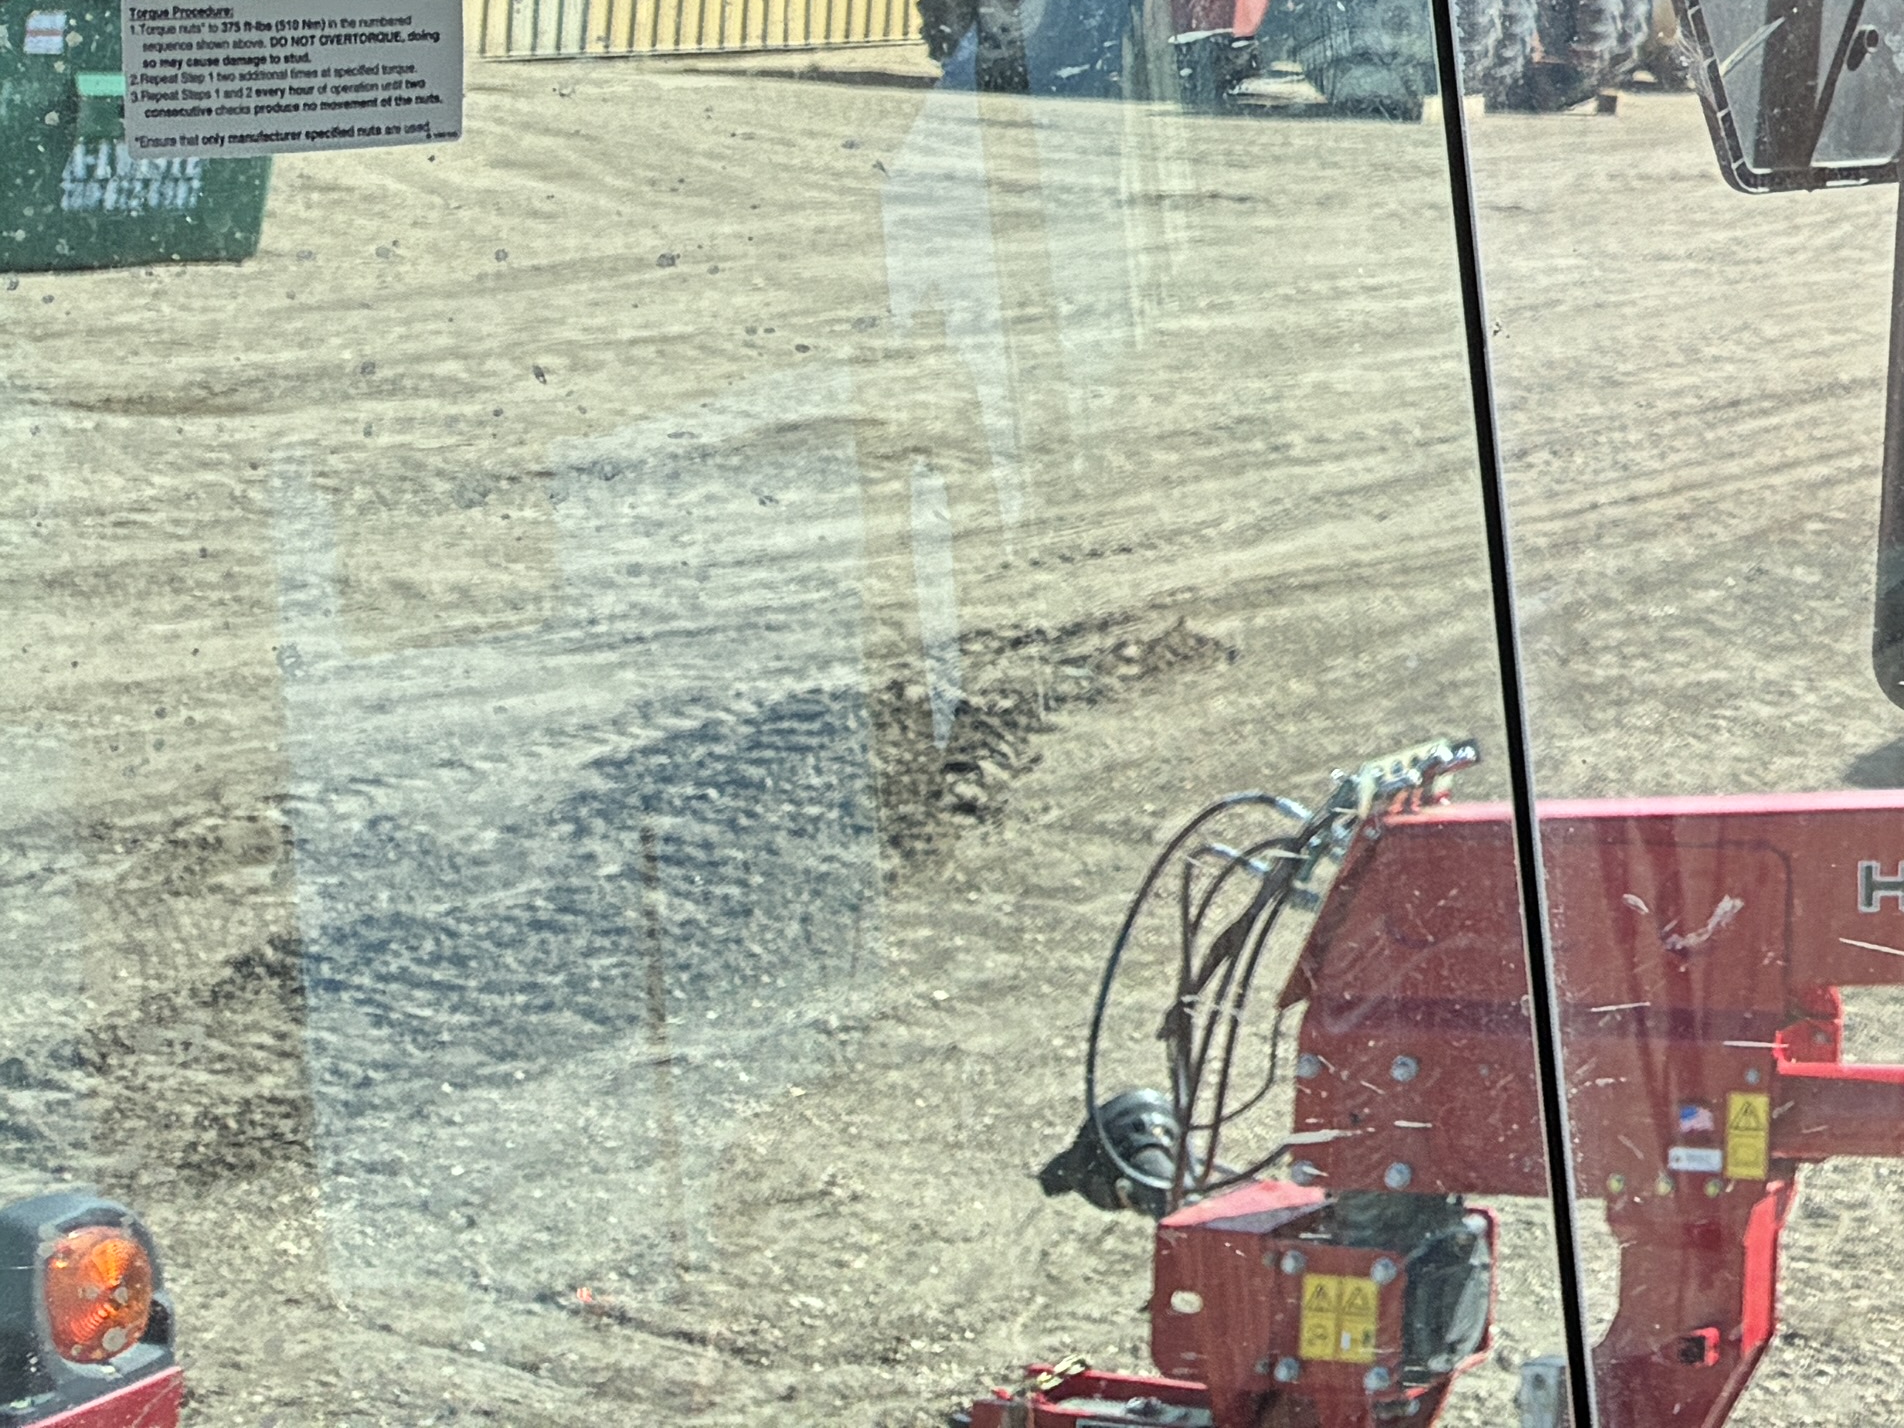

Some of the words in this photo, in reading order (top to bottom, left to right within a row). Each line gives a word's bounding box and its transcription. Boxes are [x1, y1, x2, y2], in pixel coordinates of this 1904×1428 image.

[129, 7, 169, 20] Torque
[172, 5, 233, 19] Procedure:
[208, 23, 218, 33] to
[221, 21, 241, 33] 375
[243, 20, 272, 32] ft-lbs
[328, 18, 338, 29] in
[340, 17, 356, 29] the
[358, 15, 412, 28] numbered
[142, 42, 193, 53] sequence
[196, 39, 230, 50] shown
[269, 36, 288, 48] DO
[290, 35, 316, 47] NOT
[407, 29, 440, 43] doing
[143, 59, 157, 68] so
[159, 58, 183, 70] may
[185, 57, 220, 67] cause
[222, 55, 267, 67] damage
[269, 54, 281, 64] to
[181, 72, 206, 85] Step
[216, 71, 236, 82] two
[238, 69, 288, 81] additional
[290, 67, 318, 79] times
[320, 66, 331, 78] at
[333, 63, 379, 78] specified
[181, 88, 212, 101] Steps
[223, 87, 243, 98] and
[255, 86, 286, 99] every
[288, 85, 315, 96] hour
[317, 82, 327, 94] of
[330, 81, 379, 96] operation
[405, 78, 426, 89] two
[145, 106, 213, 118] consecutive
[253, 102, 300, 116] produce
[302, 101, 318, 112] no
[320, 97, 378, 111] movement
[380, 95, 392, 107] of
[394, 94, 413, 106] the
[179, 133, 199, 146] that
[201, 133, 226, 147] only
[228, 129, 302, 144] manufacturer
[305, 125, 355, 142] specified
[357, 124, 382, 136] nuts
[384, 124, 402, 136] are
